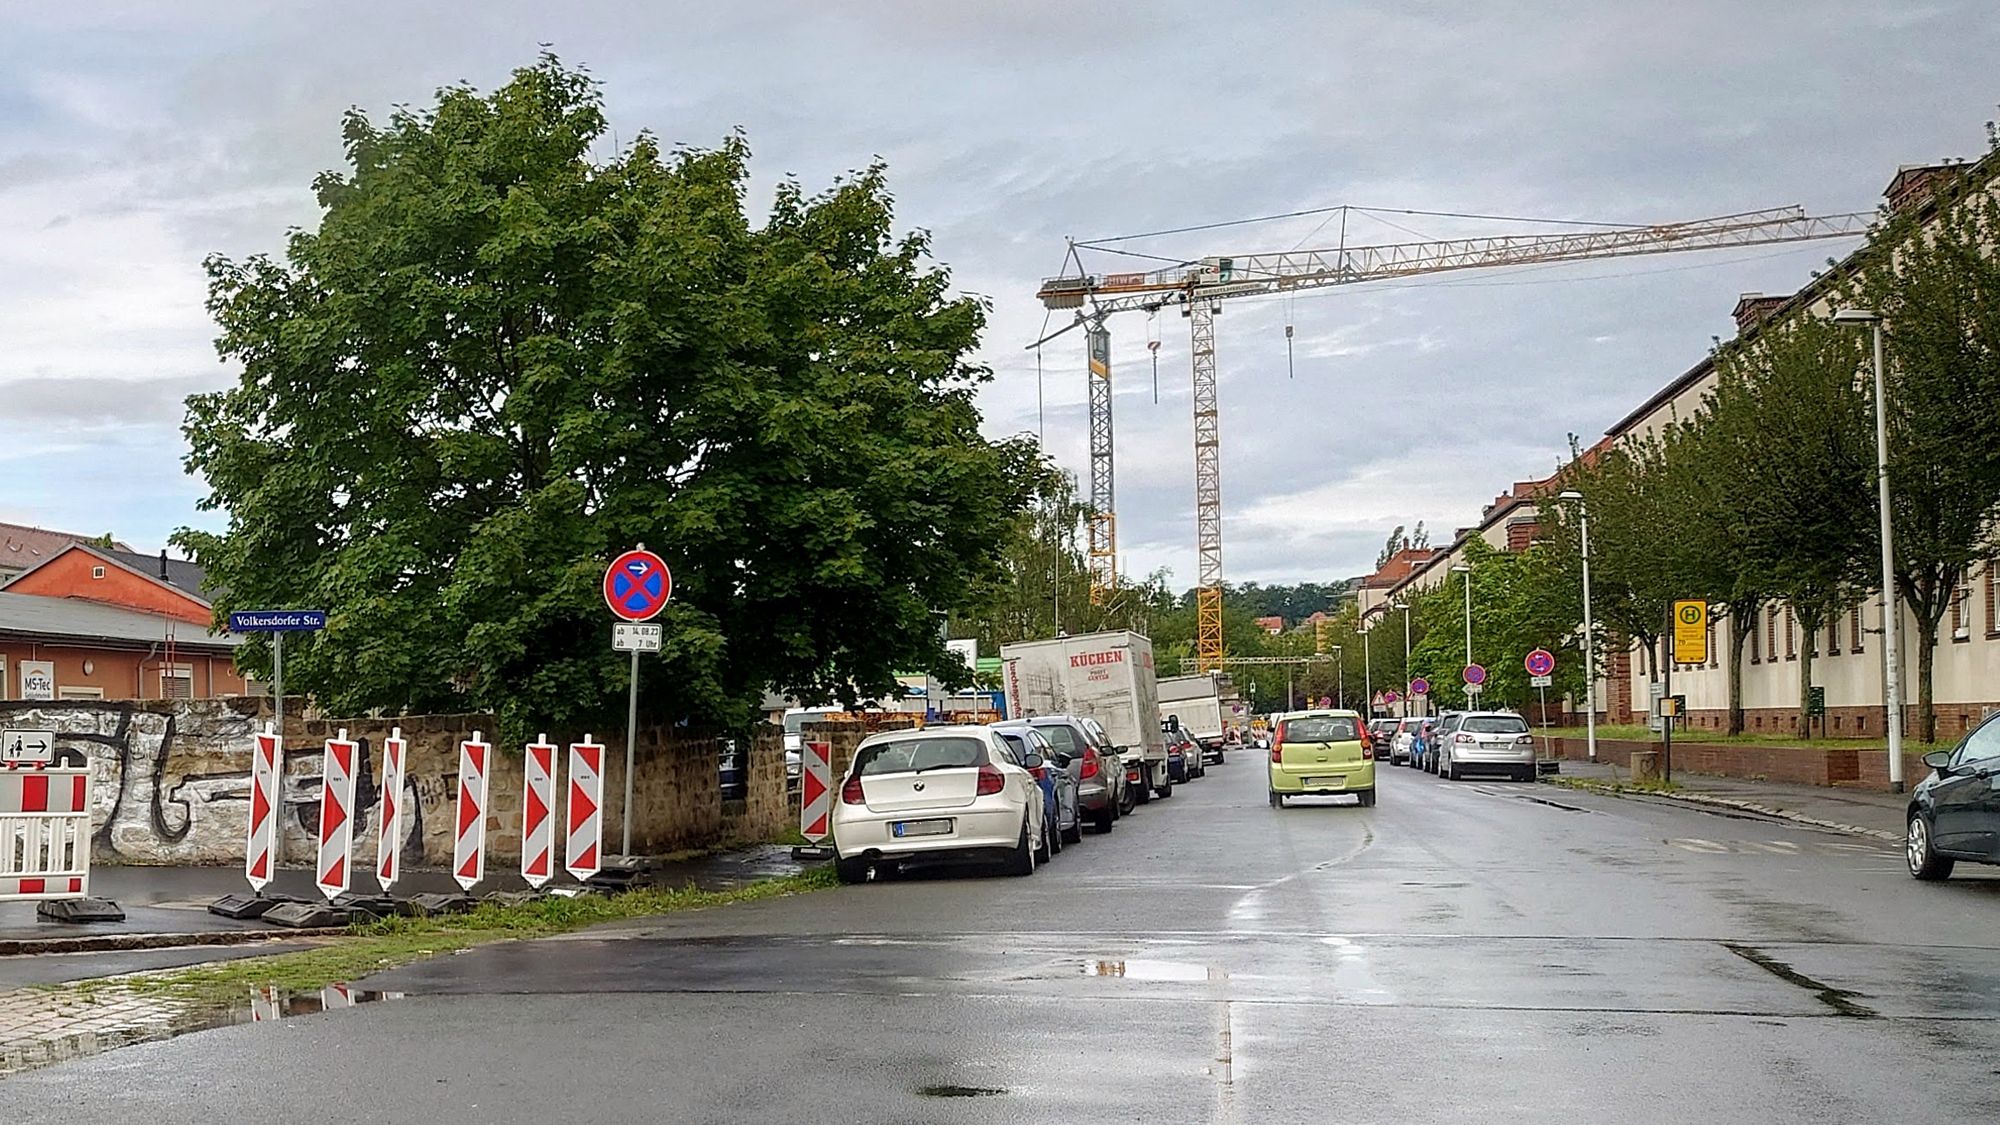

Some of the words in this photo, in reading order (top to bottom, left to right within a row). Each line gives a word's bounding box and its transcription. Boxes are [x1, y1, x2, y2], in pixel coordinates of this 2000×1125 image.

[236, 615, 300, 626] Volkersdorfer
[303, 615, 320, 625] Str.
[617, 626, 624, 635] ab
[616, 639, 624, 647] ab
[638, 639, 643, 647] 7
[646, 640, 657, 648] Uhr
[1070, 650, 1123, 668] KÜCHEN
